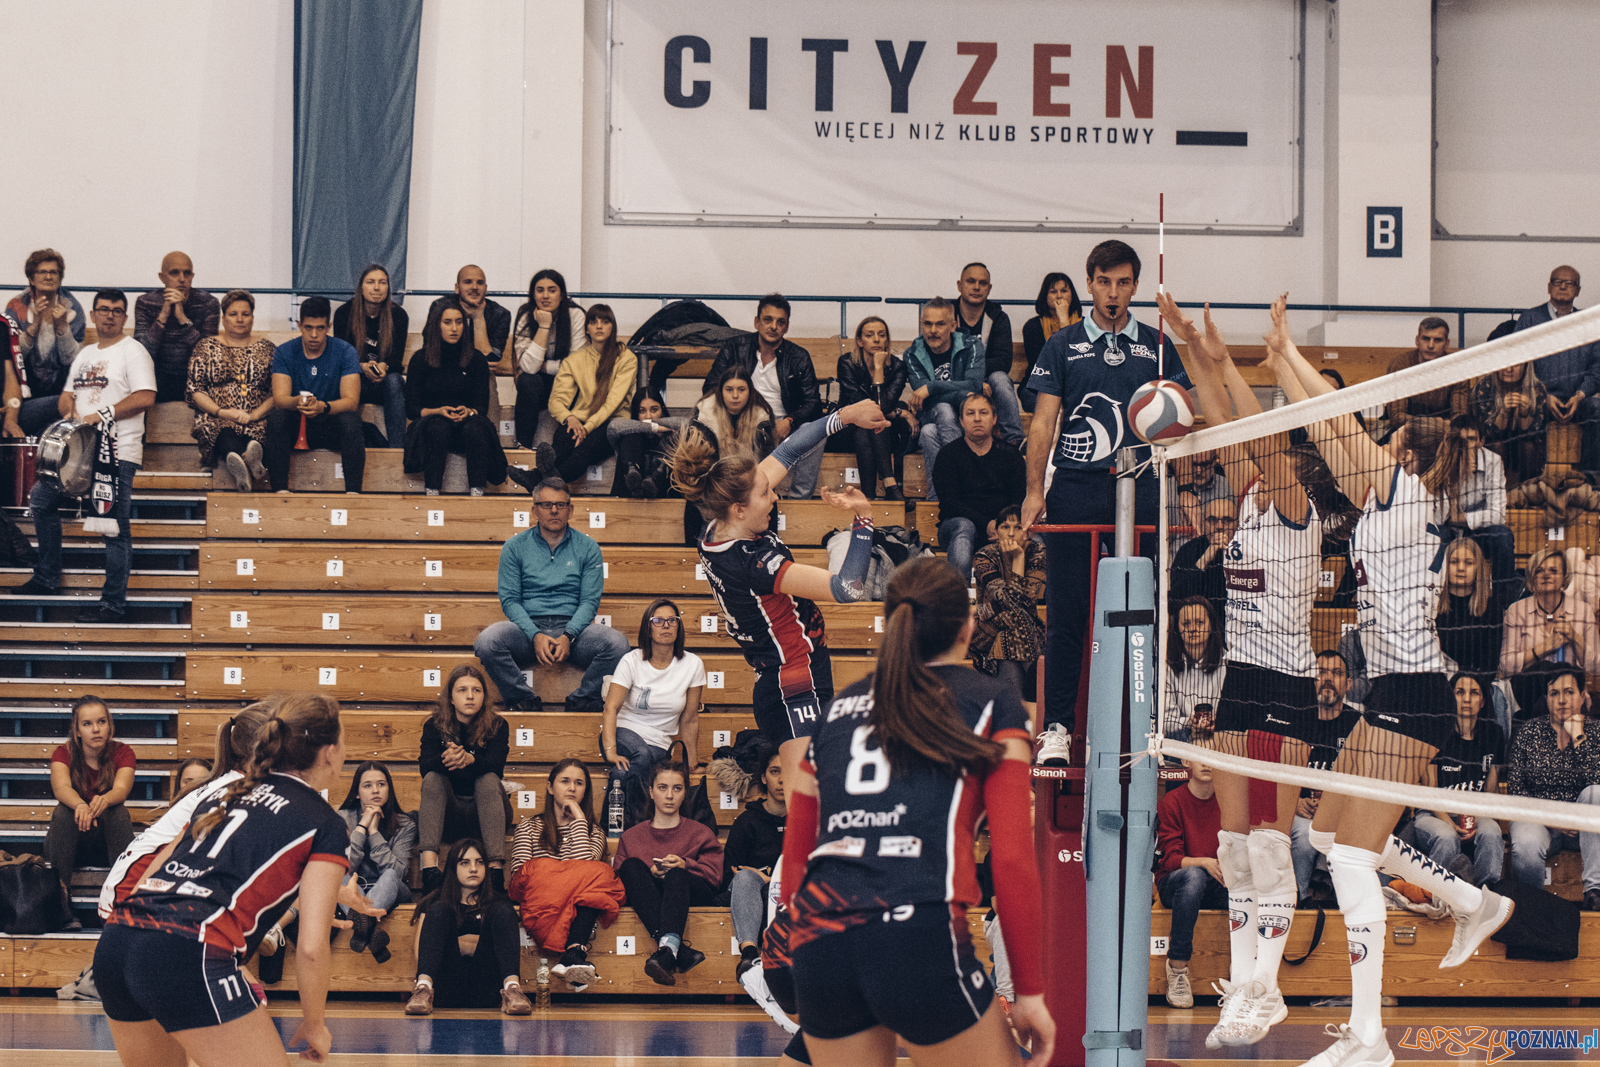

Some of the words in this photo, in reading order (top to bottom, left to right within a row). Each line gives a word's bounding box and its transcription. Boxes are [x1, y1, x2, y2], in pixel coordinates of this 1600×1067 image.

[664, 35, 1154, 119] CITYZEN
[815, 121, 895, 142] WIĘCEJ
[909, 121, 945, 141] NIŻ
[959, 124, 1017, 142] KLUB
[1030, 125, 1155, 145] SPORTOWY
[1374, 214, 1396, 250] B
[1230, 574, 1258, 589] Energa
[1321, 573, 1332, 583] 12
[1132, 648, 1145, 703] Senoh
[793, 704, 817, 724] 14
[844, 724, 892, 795] 8
[1032, 768, 1067, 778] Senoh
[1160, 770, 1188, 779] Senoh
[1154, 939, 1166, 949] 15
[218, 976, 243, 1002] 11
